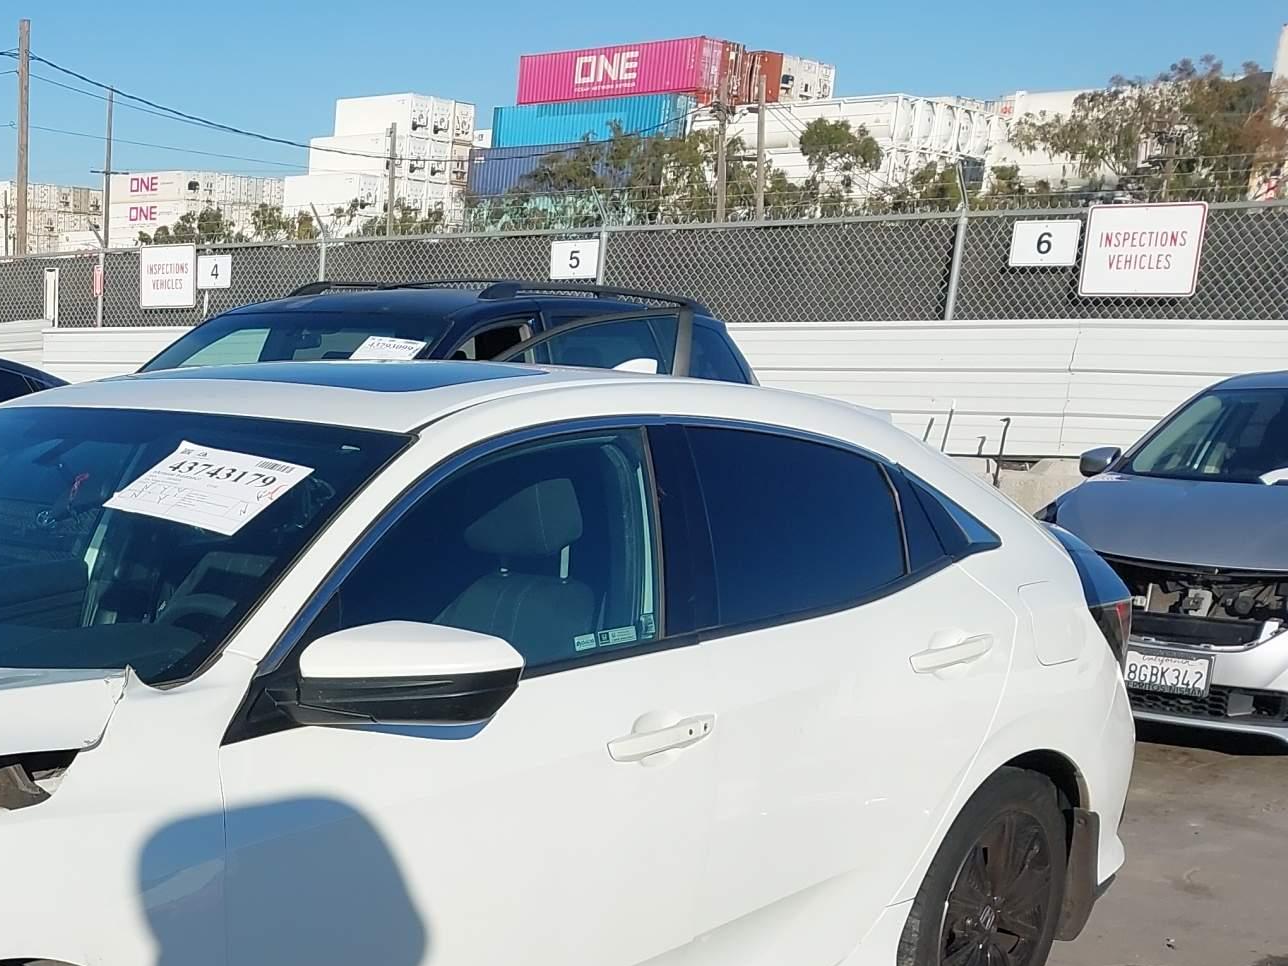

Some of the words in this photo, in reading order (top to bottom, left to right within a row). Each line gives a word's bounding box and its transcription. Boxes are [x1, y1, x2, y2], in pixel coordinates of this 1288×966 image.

[575, 51, 639, 84] ONE
[130, 177, 158, 192] ONE
[129, 206, 157, 221] ONE
[1036, 232, 1052, 254] 6
[1099, 231, 1188, 248] INSPECTIONS
[569, 250, 580, 269] 5
[1108, 254, 1172, 270] VEHICLES
[146, 263, 189, 275] INSPECTIONS
[211, 264, 219, 279] 4
[152, 279, 183, 290] VEHICLES
[169, 460, 277, 488] 43743179
[1127, 663, 1203, 688] 8GBK342
